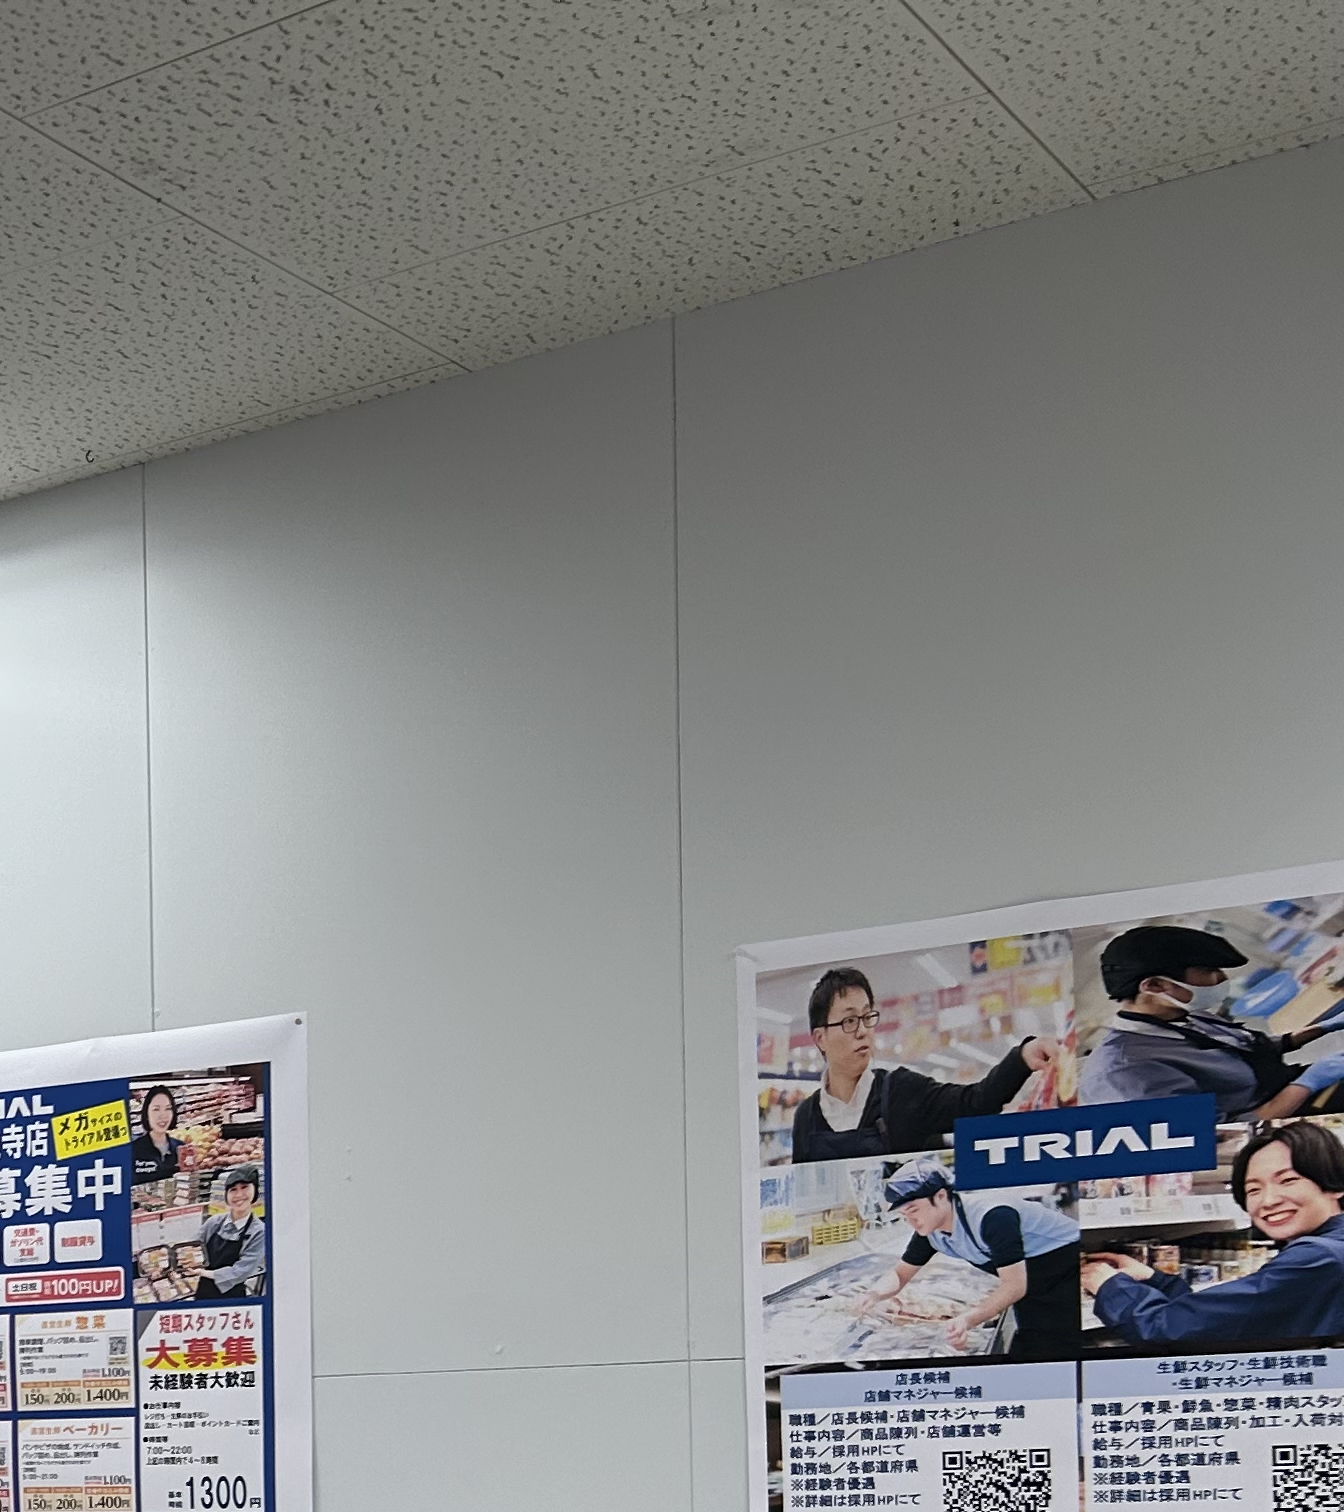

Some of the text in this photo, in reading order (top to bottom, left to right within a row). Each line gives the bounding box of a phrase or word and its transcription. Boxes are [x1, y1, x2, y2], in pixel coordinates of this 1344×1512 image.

[974, 1122, 1194, 1165] TRIAL
[159, 1311, 255, 1334] 短期スタッフさん
[145, 1336, 258, 1369] 大募集
[149, 1371, 256, 1391] 未経験者大歓迎
[895, 1371, 951, 1386] 店長候補
[864, 1385, 982, 1403] 店舗マネジャー候補
[1091, 1394, 1344, 1417] 職種／青果・鮮魚・惣菜・精肉スタッ
[788, 1405, 1025, 1427] 職種／店長候補・店舗マネジャー候補
[63, 1423, 123, 1436] ベーカリー
[789, 1423, 1002, 1444] 仕事内容／商品陳列・店舗運営等
[790, 1443, 906, 1459] 給与／採用HPにて
[1092, 1435, 1225, 1451] 給与／採用HPにて
[790, 1459, 919, 1476] 勤務地／各都道府県
[1093, 1451, 1241, 1469] 勤務地／各都道府県
[791, 1477, 875, 1492] ※経験者優遇
[1093, 1470, 1191, 1486] ※経験者優遇
[791, 1493, 922, 1508] ※詳細は採用HPにて
[1093, 1488, 1244, 1504] ※詳細は採用HPにて
